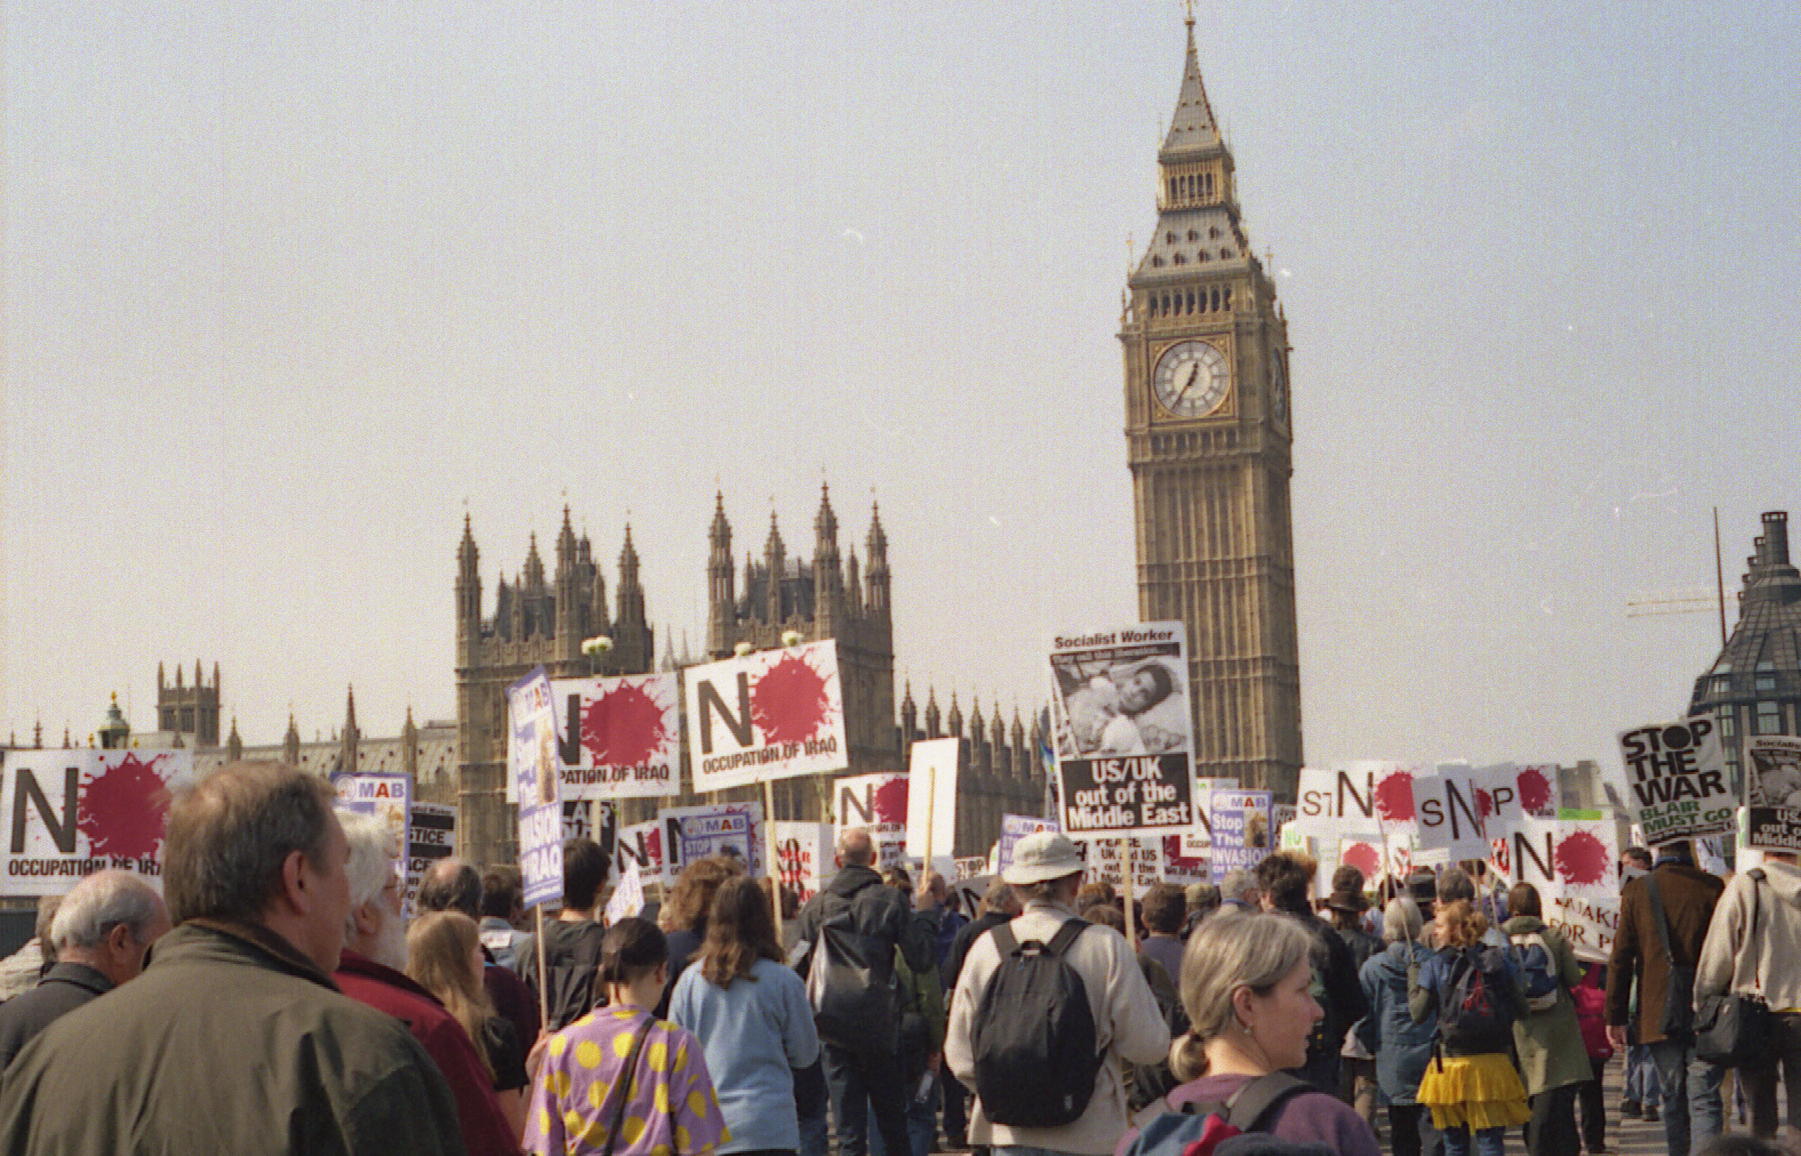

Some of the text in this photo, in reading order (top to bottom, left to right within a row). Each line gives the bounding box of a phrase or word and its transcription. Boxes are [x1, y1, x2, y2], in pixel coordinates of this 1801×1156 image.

[1055, 630, 1173, 648] Socialist Worker
[1622, 720, 1712, 758] STOP
[702, 735, 837, 775] OCCUPATION OF IRAQ
[1627, 749, 1699, 781] THE
[611, 767, 630, 781] OF
[635, 764, 670, 781] IRAQ
[1091, 756, 1162, 783] US/UK
[359, 783, 405, 798] MAB
[1075, 779, 1177, 806] out of the
[1633, 770, 1726, 806] WAR
[1232, 797, 1266, 809] MAB
[1640, 801, 1701, 820] BLAIR
[706, 819, 745, 832] MAB
[1068, 806, 1135, 830] Middle
[1141, 802, 1189, 825] East
[1212, 813, 1244, 835] Stop
[1643, 813, 1699, 834] MUST
[1704, 808, 1732, 822] GO
[1214, 833, 1244, 847] The
[1142, 850, 1157, 861] US
[1139, 863, 1156, 873] the
[1137, 875, 1161, 887] East
[1550, 917, 1586, 945] FOR
